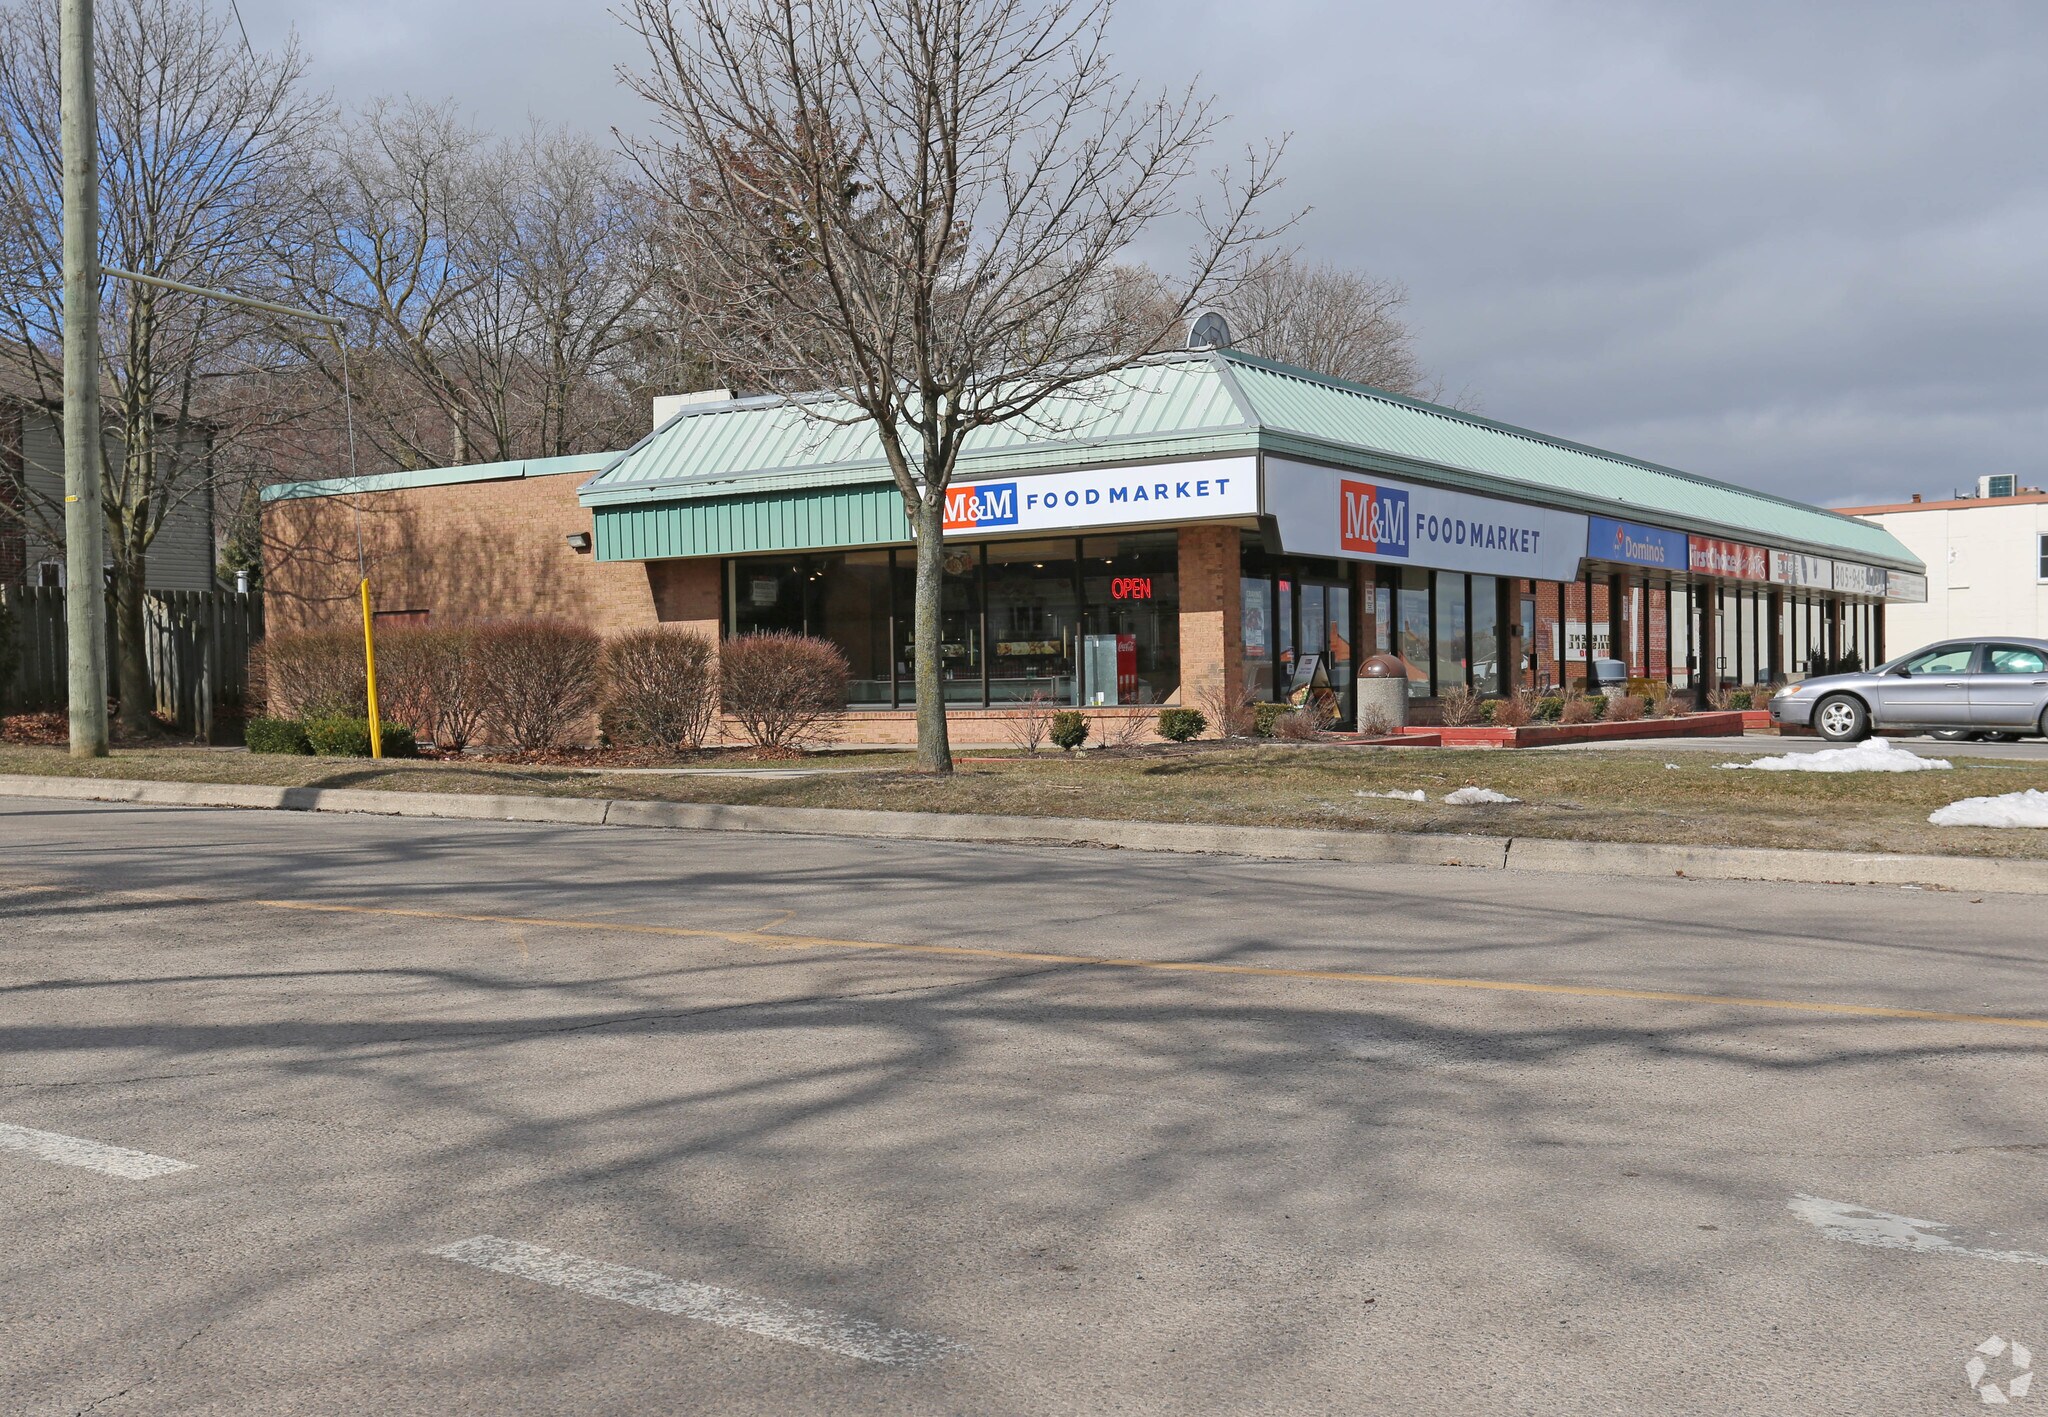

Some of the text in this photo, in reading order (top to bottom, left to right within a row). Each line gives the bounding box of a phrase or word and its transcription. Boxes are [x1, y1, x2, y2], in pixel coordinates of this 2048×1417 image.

[942, 478, 1231, 524] M&M FOOD MARKET
[1345, 491, 1540, 554] M&M FOOD MARKET
[1625, 536, 1665, 563] Domino's
[1111, 577, 1151, 599] OPEN
